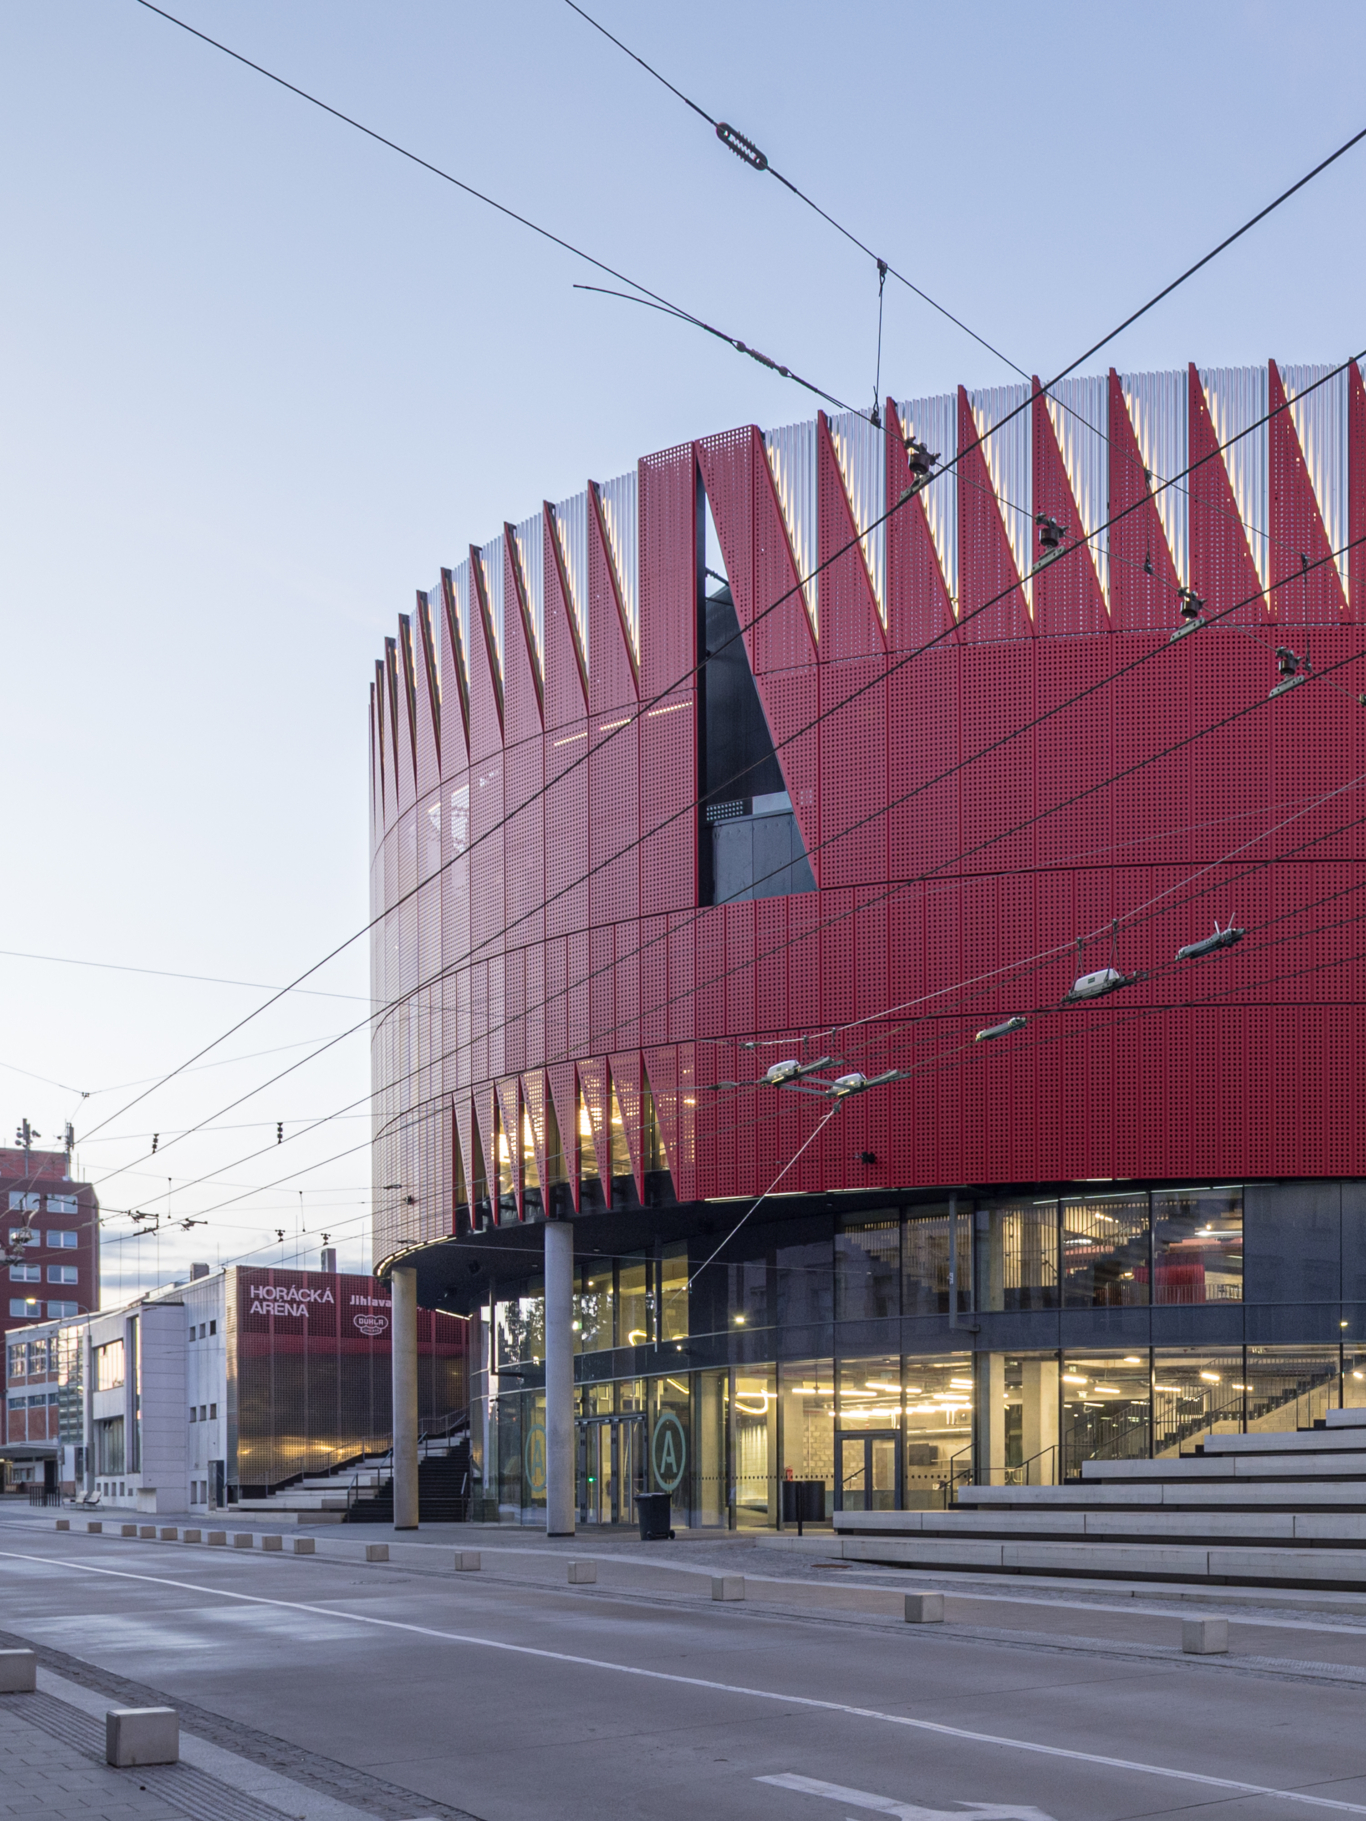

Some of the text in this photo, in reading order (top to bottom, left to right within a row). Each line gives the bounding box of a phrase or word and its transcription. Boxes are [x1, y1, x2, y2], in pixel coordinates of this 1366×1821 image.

[250, 1284, 334, 1304] HORÁCKÁ
[350, 1295, 392, 1307] Jihlava
[250, 1299, 309, 1318] ARÉNA
